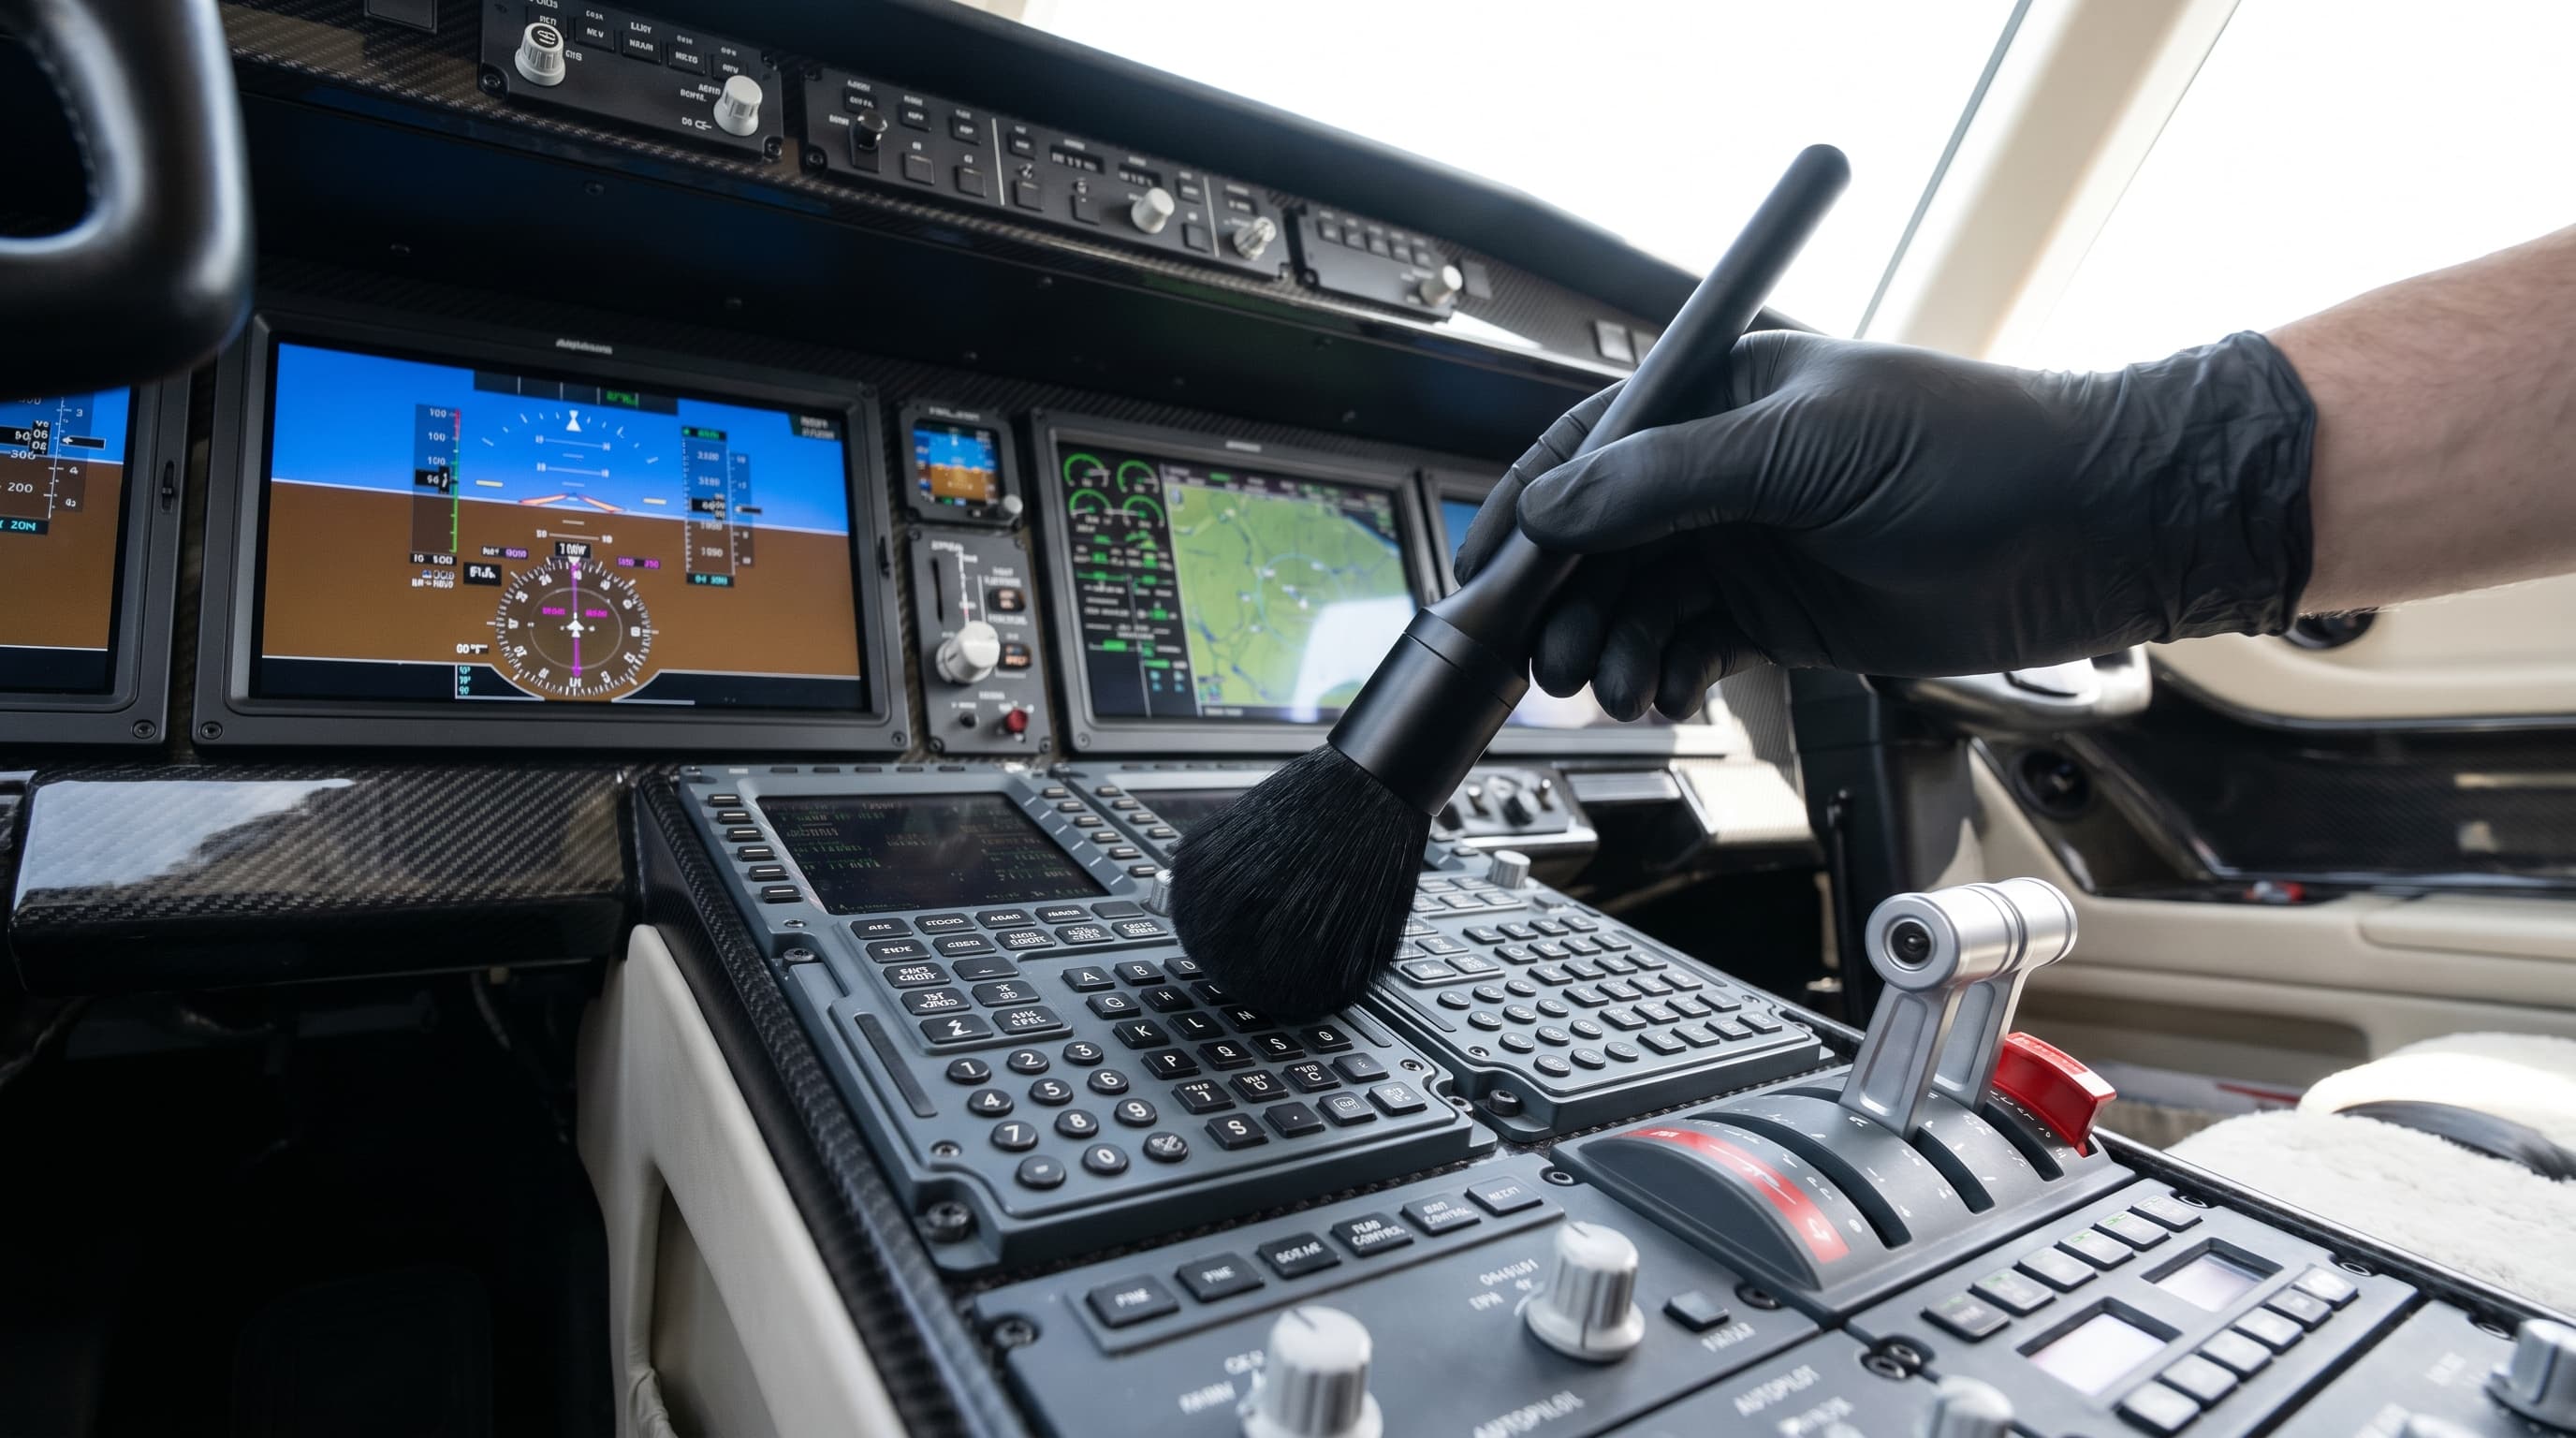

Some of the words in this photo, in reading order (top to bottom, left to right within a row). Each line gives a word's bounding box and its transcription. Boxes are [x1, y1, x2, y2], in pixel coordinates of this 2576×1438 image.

[7, 481, 34, 493] 200
[1133, 965, 1149, 976] B
[1179, 960, 1196, 970] D
[1082, 972, 1101, 982] A
[1187, 1018, 1205, 1028] L
[1134, 1025, 1153, 1037] K
[1075, 1044, 1093, 1056] 3
[1019, 1052, 1039, 1065] 2
[1164, 1055, 1177, 1067] P
[959, 1062, 977, 1075] 1
[1099, 1073, 1119, 1086] 6
[1044, 1082, 1061, 1095] 5
[984, 1093, 1001, 1108] 4
[1127, 1102, 1148, 1118] 9
[1069, 1113, 1087, 1128] 8
[1003, 1124, 1020, 1142] 7
[1096, 1149, 1116, 1165] 0
